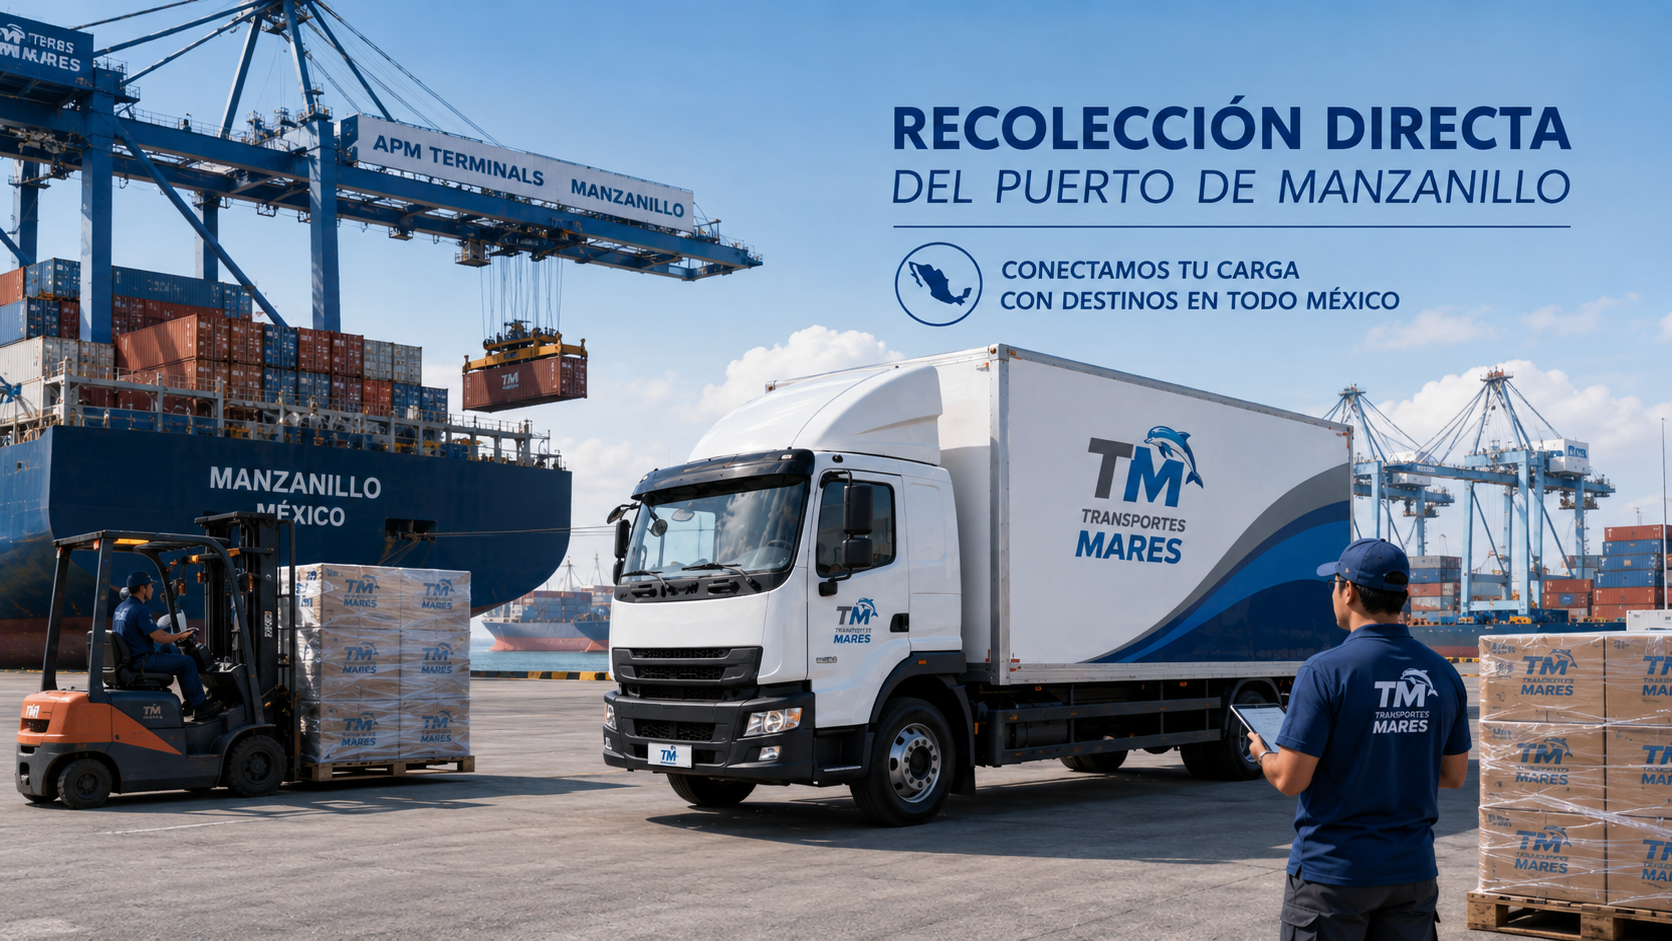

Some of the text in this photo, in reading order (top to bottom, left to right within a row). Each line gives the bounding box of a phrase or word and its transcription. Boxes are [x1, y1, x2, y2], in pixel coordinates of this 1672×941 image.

[373, 134, 685, 219] APM TERMINALS MANZANILLO
[1088, 437, 1185, 507] TM
[209, 466, 382, 500] MANZANILLO
[1082, 508, 1187, 533] TRANSPORTES
[1075, 529, 1184, 565] MARES
[345, 579, 375, 594] TM
[423, 583, 450, 597] TM
[343, 598, 378, 608] MARES
[421, 601, 454, 610] MARES
[836, 606, 871, 625] TM
[833, 634, 871, 644] MARES
[344, 647, 374, 661] TM
[422, 648, 449, 661] TM
[1522, 656, 1569, 676] TM
[1374, 681, 1426, 708] TM
[1520, 684, 1574, 697] MARES
[343, 718, 374, 731] TM
[421, 715, 449, 729] TM
[1373, 720, 1429, 734] MARES
[660, 749, 677, 762] TM
[1517, 743, 1564, 765] TM
[1515, 771, 1569, 785] MARES
[1516, 830, 1563, 854] TM
[1514, 858, 1569, 875] MARES
